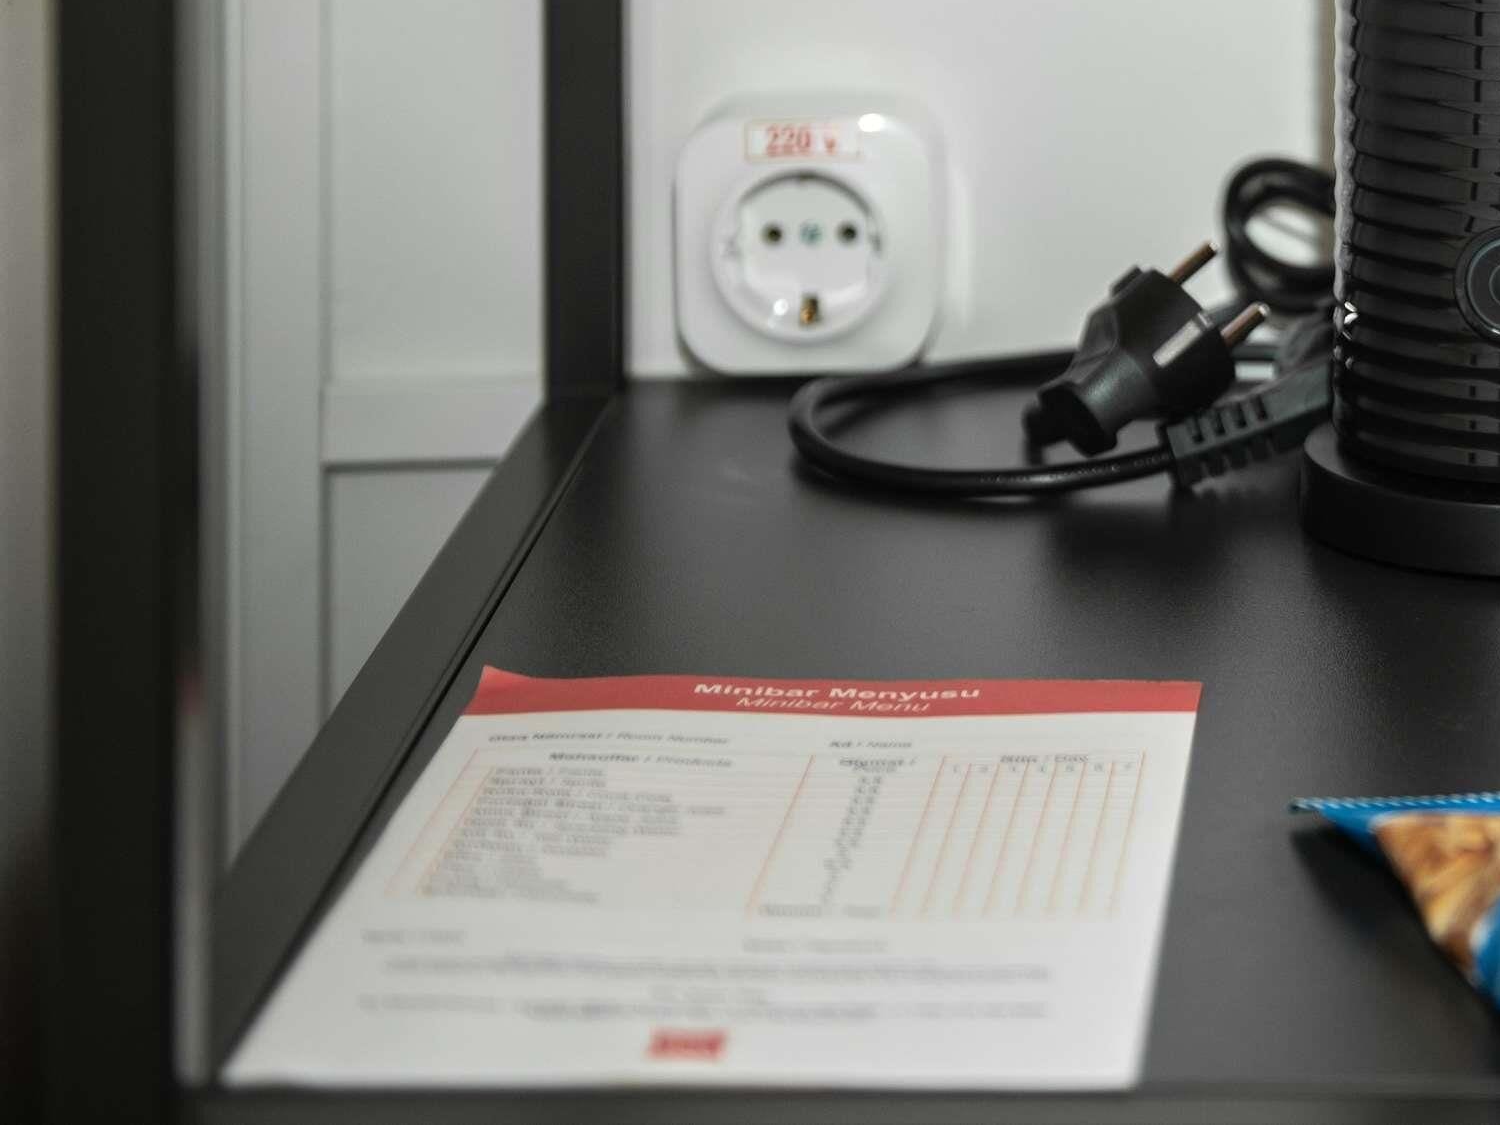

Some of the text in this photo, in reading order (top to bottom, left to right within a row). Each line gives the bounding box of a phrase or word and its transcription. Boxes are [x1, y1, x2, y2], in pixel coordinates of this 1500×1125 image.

[766, 125, 812, 157] 220
[693, 683, 981, 702] Minibar Menyusu
[735, 696, 931, 713] Minibar Menu
